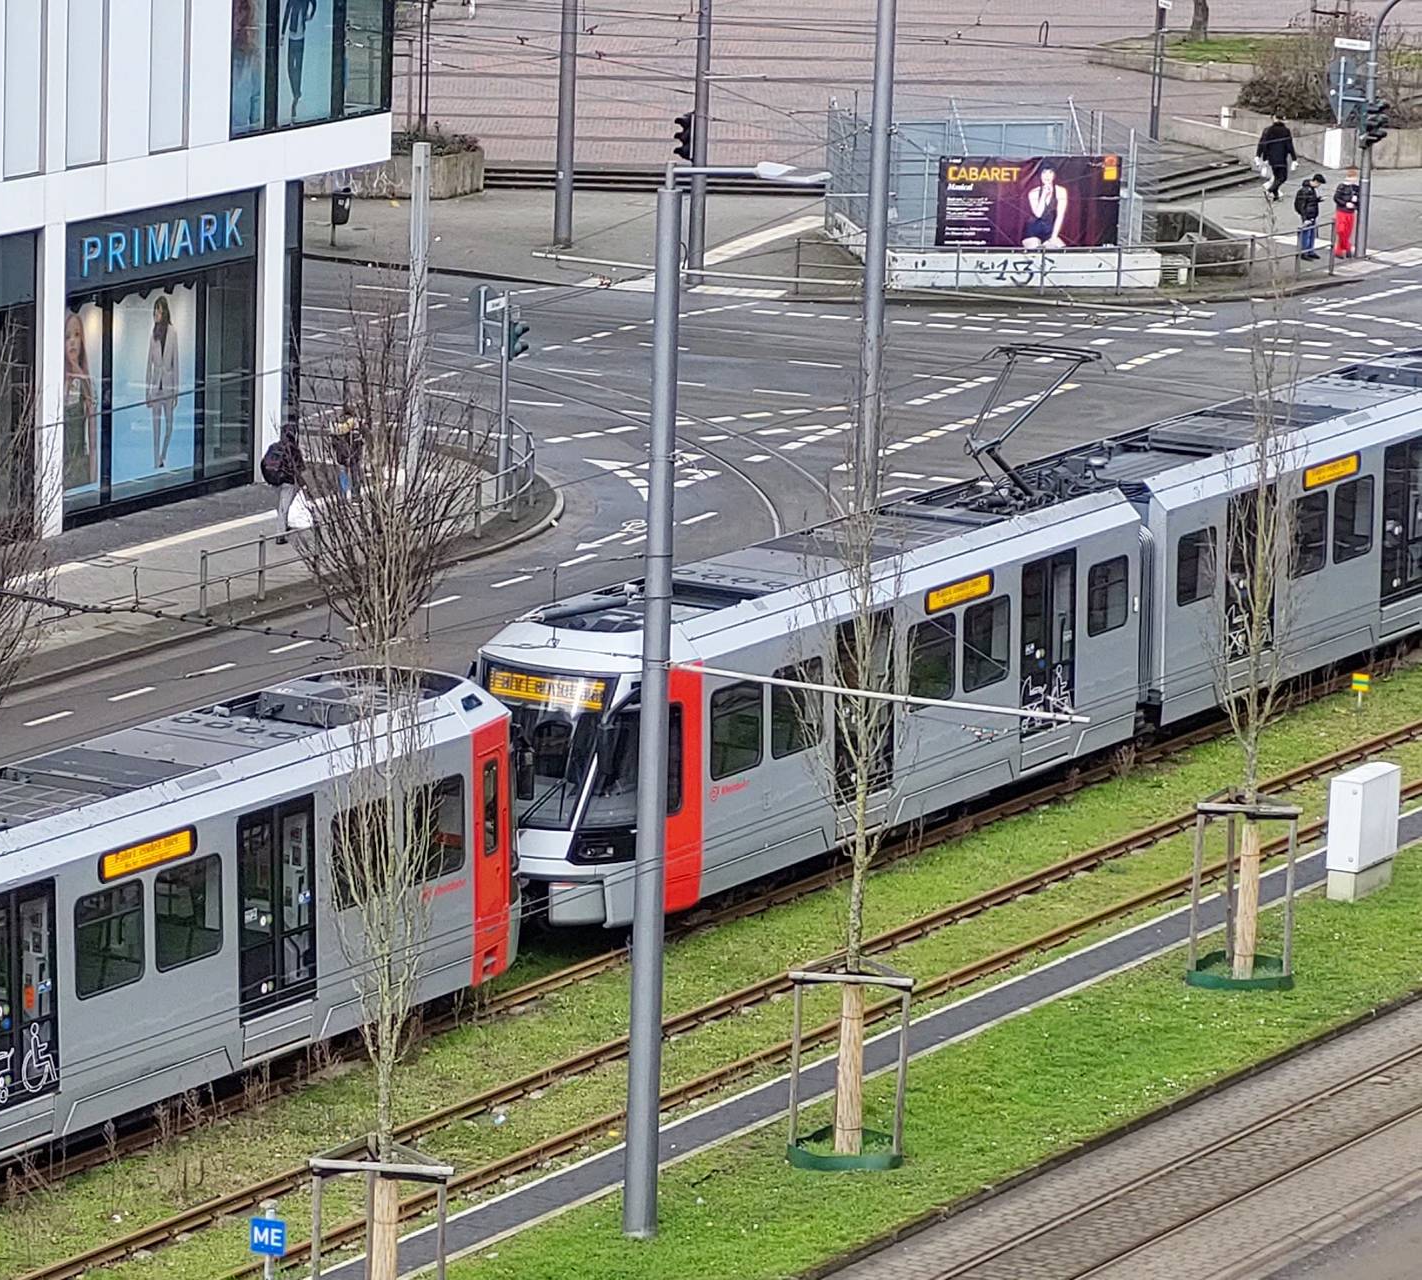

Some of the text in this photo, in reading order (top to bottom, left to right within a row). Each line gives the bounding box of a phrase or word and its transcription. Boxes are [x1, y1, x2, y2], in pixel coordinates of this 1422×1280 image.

[948, 166, 1021, 182] CABARET
[81, 208, 243, 277] PRIMARK
[253, 1225, 283, 1247] ME
